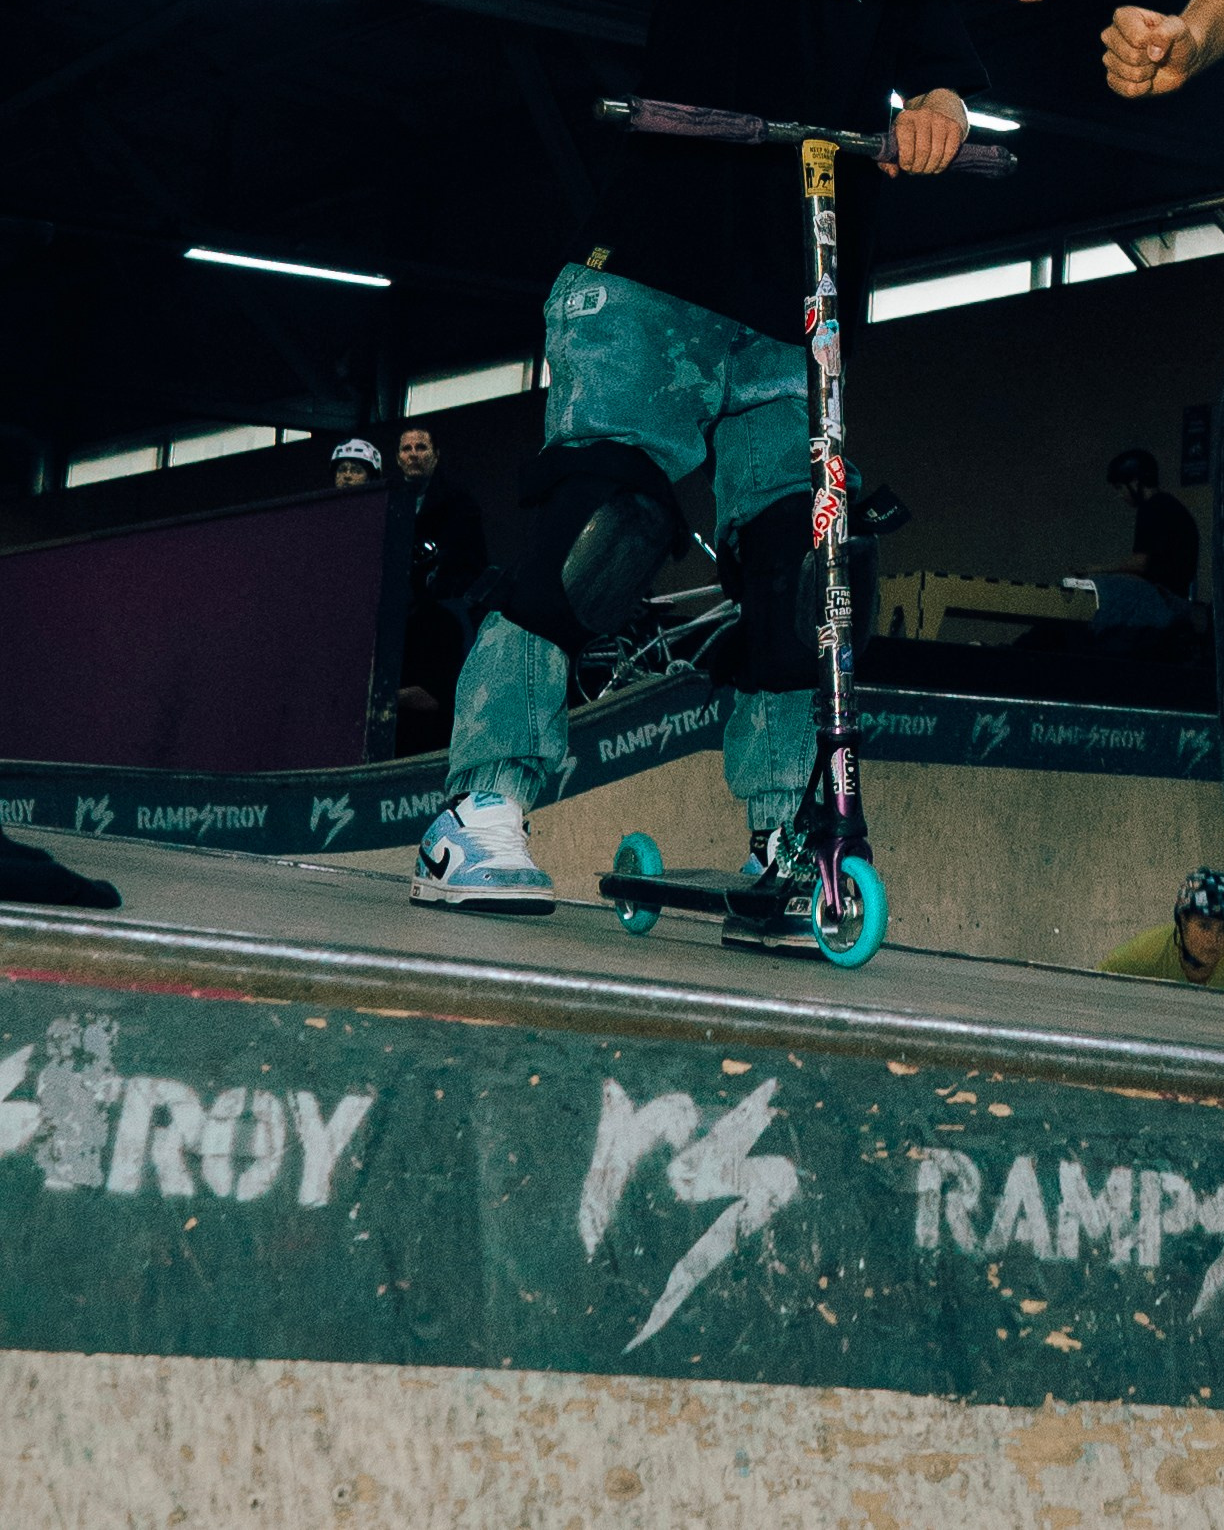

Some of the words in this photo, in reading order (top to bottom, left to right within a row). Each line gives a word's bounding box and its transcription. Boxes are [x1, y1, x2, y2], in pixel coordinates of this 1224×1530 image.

[598, 700, 720, 763] RAMPSTROY
[1031, 722, 1146, 752] RAMPSTROY
[137, 803, 268, 837] RAMPSTROY
